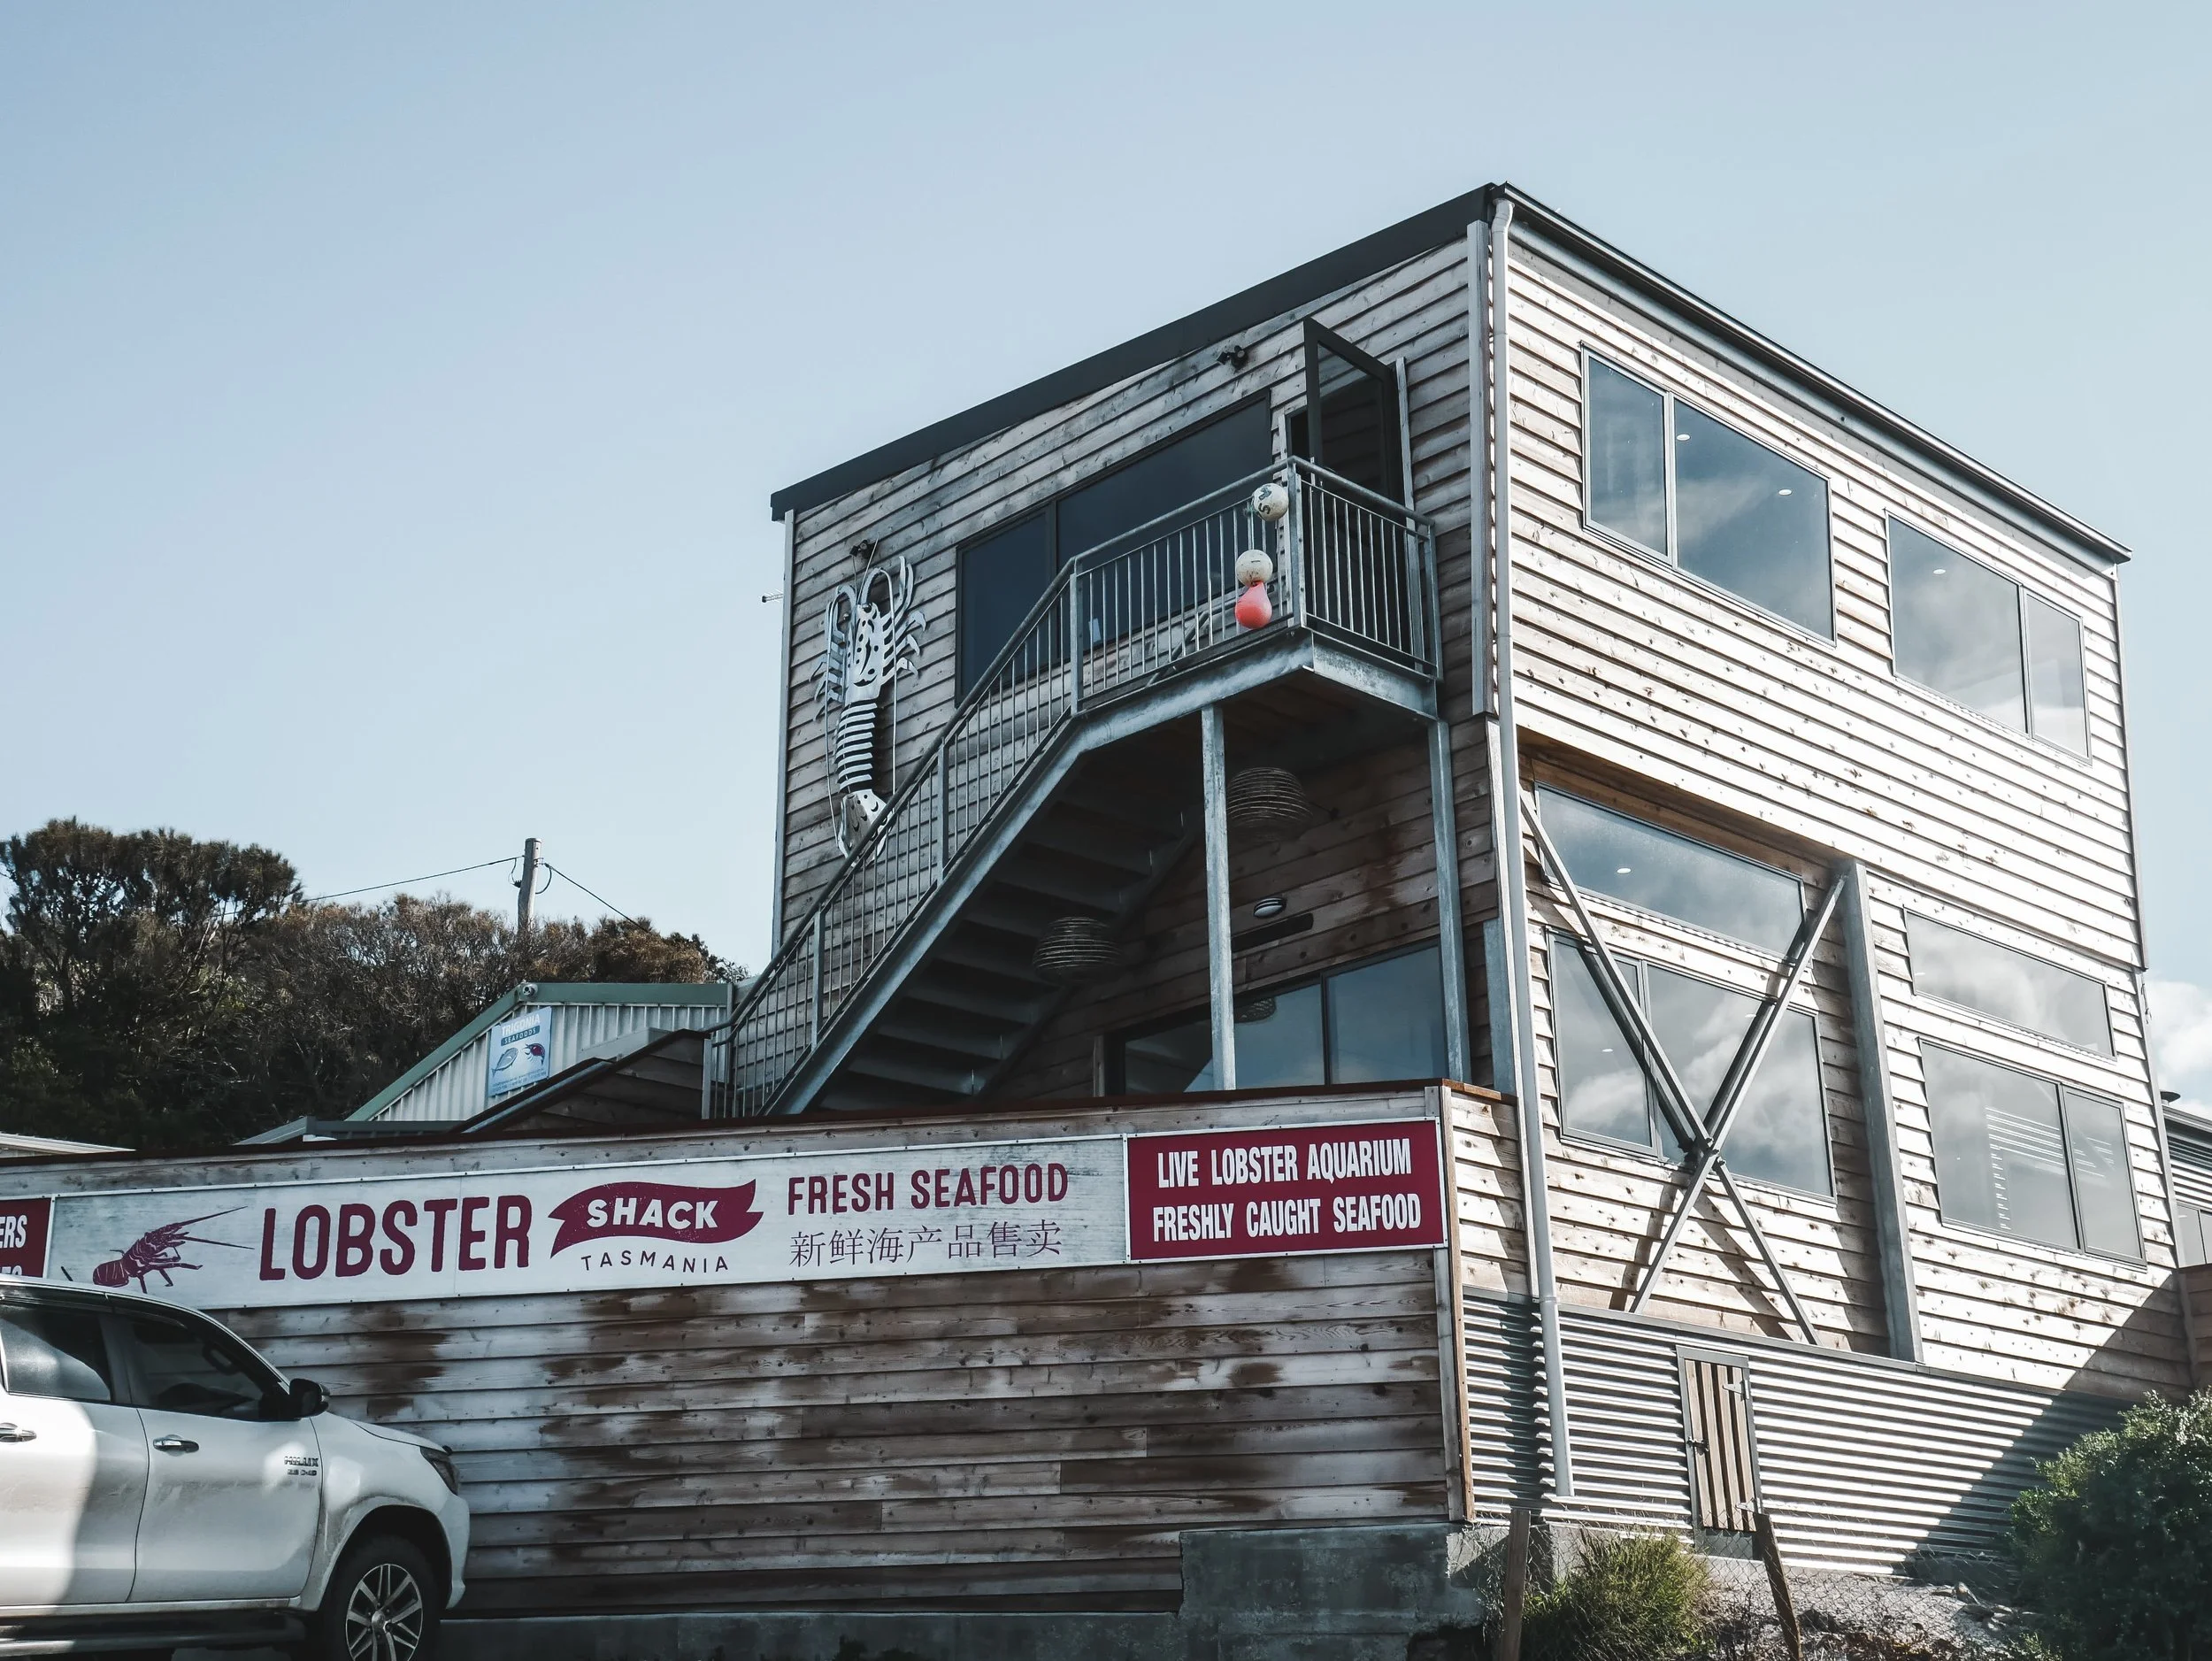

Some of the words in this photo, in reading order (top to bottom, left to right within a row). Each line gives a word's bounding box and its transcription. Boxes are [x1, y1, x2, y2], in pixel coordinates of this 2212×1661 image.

[502, 1014, 541, 1036] TRIGONIA
[504, 1027, 536, 1044] SEAFOODS
[1157, 1150, 1199, 1188] LIVE
[1210, 1144, 1299, 1186] LOBSTER
[1307, 1139, 1411, 1183] AQUARIUM
[586, 1197, 718, 1230] SHACK
[787, 1173, 895, 1216] FRESH
[910, 1163, 1070, 1210] SEAFOOD
[259, 1195, 533, 1280] LOBSTER
[1153, 1203, 1234, 1242] FRESHLY
[1246, 1198, 1321, 1238] CAUGHT
[1333, 1193, 1421, 1234] SEAFOOD
[580, 1250, 729, 1273] TASMANIA
[788, 1219, 1063, 1268] 新鲜海产品售卖
